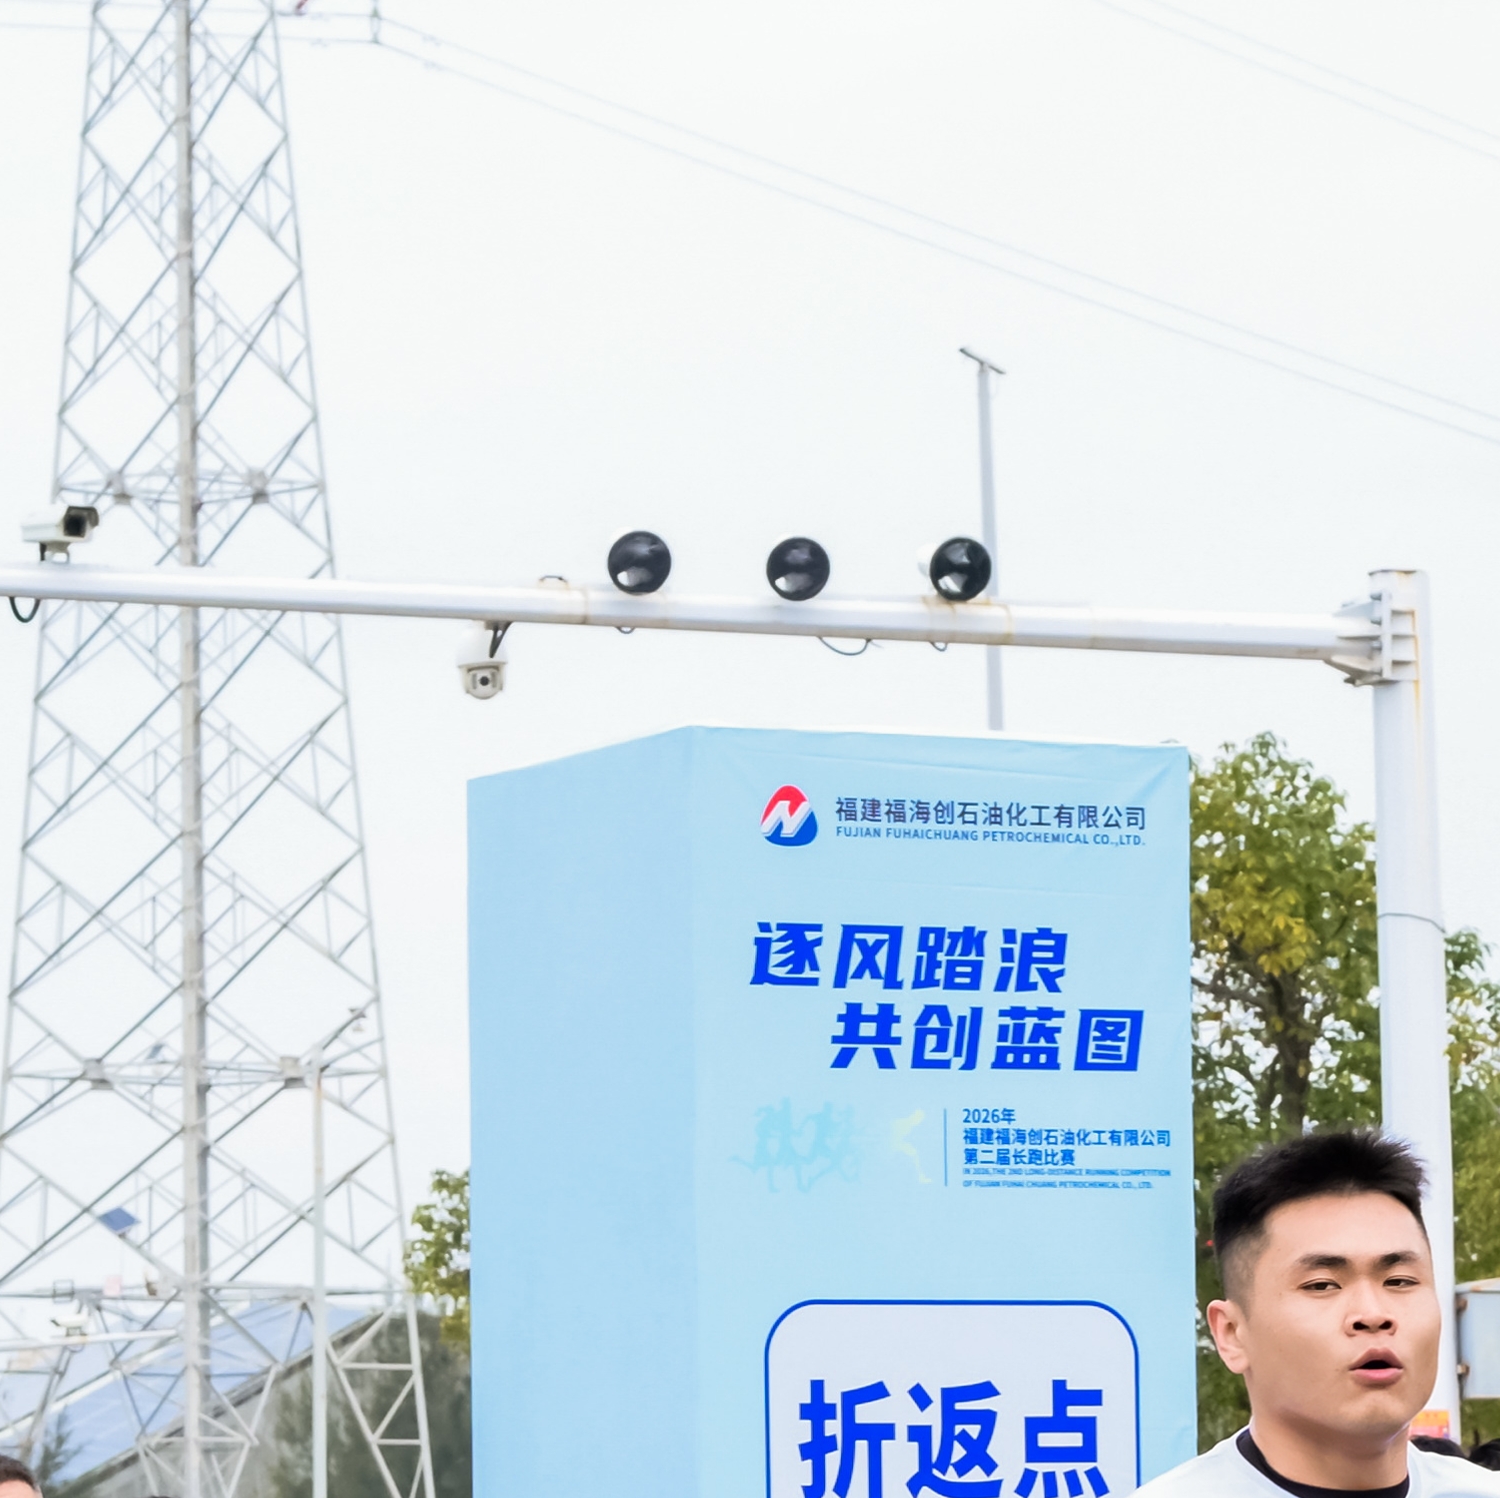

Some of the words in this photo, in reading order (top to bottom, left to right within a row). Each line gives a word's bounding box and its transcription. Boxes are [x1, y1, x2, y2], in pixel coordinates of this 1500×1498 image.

[835, 797, 1147, 831] 福建福海创石油化工有限公司
[836, 826, 882, 839] FUJIAN
[886, 828, 979, 842] FUHAICHUANG
[983, 831, 1090, 845] PETROCHEMICAL
[750, 921, 1068, 993] 逐风踏浪
[830, 1002, 1145, 1072] 共创蓝图
[962, 1107, 1017, 1125] 2026年
[963, 1128, 1172, 1147] 福建福海创石油化工有限公司
[963, 1148, 1076, 1166] 第二届长跑比赛
